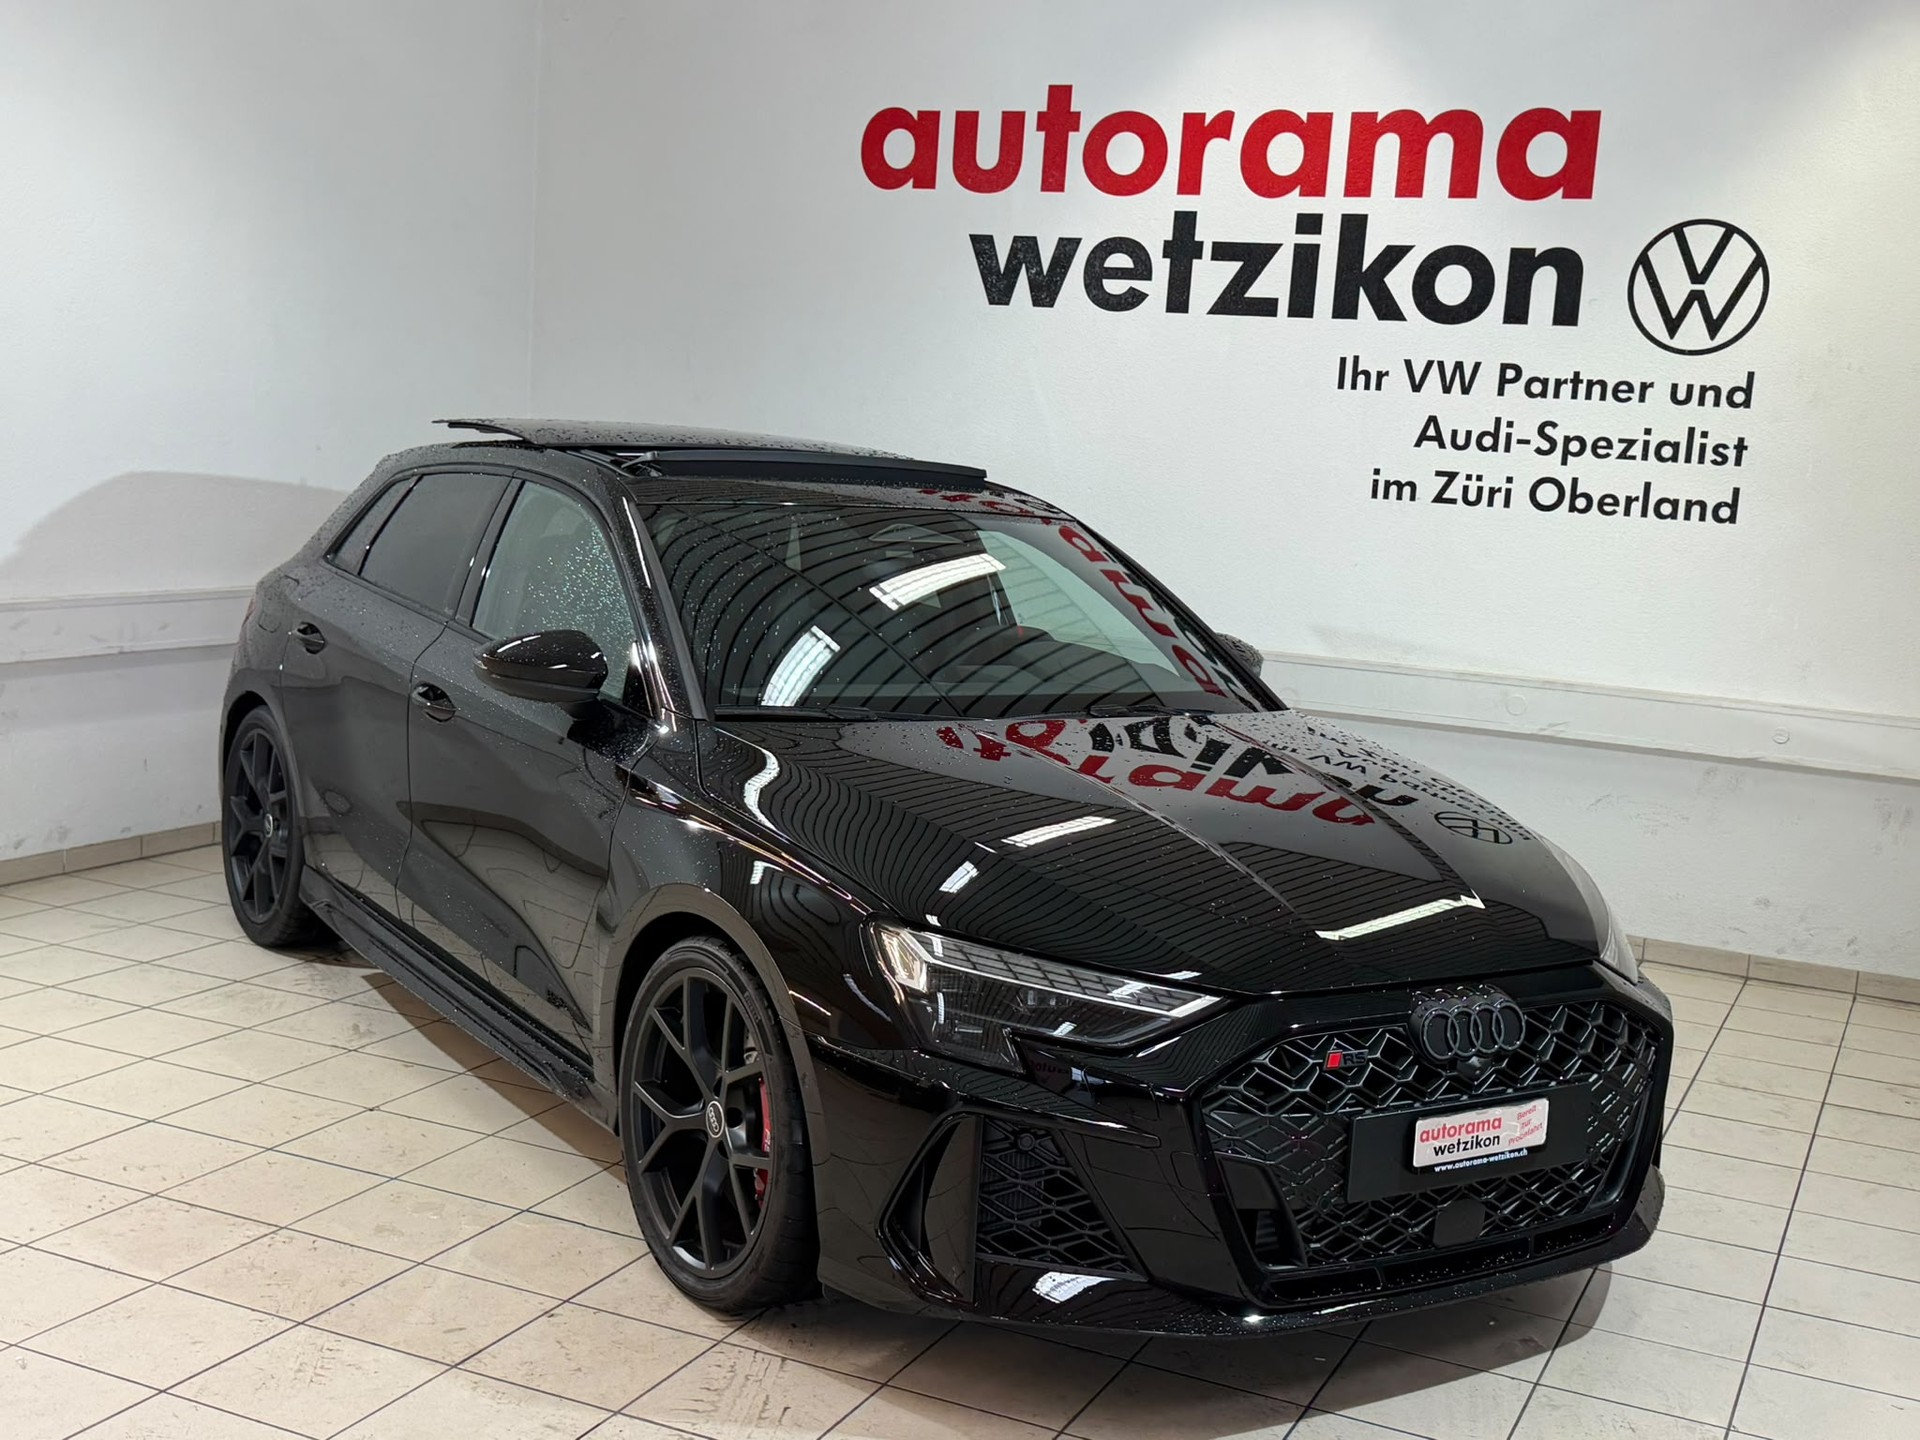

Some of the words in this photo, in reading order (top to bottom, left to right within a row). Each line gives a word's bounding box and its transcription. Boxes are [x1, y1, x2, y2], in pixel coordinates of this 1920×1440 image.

[860, 84, 1602, 202] autorama
[968, 210, 1584, 327] wetzikon
[1337, 356, 1391, 392] Ihr
[1403, 358, 1482, 396] VW
[1496, 362, 1655, 406] Partner
[1669, 370, 1756, 409] und
[1413, 414, 1750, 467] Audi-Spezialist
[1371, 467, 1417, 502] im
[1430, 470, 1514, 511] Züri
[1528, 476, 1741, 525] Oberland
[1420, 1117, 1503, 1143] autorama
[1433, 1135, 1501, 1157] wetzikon
[1434, 1148, 1528, 1172] www.autorama-wetzikon.ch
